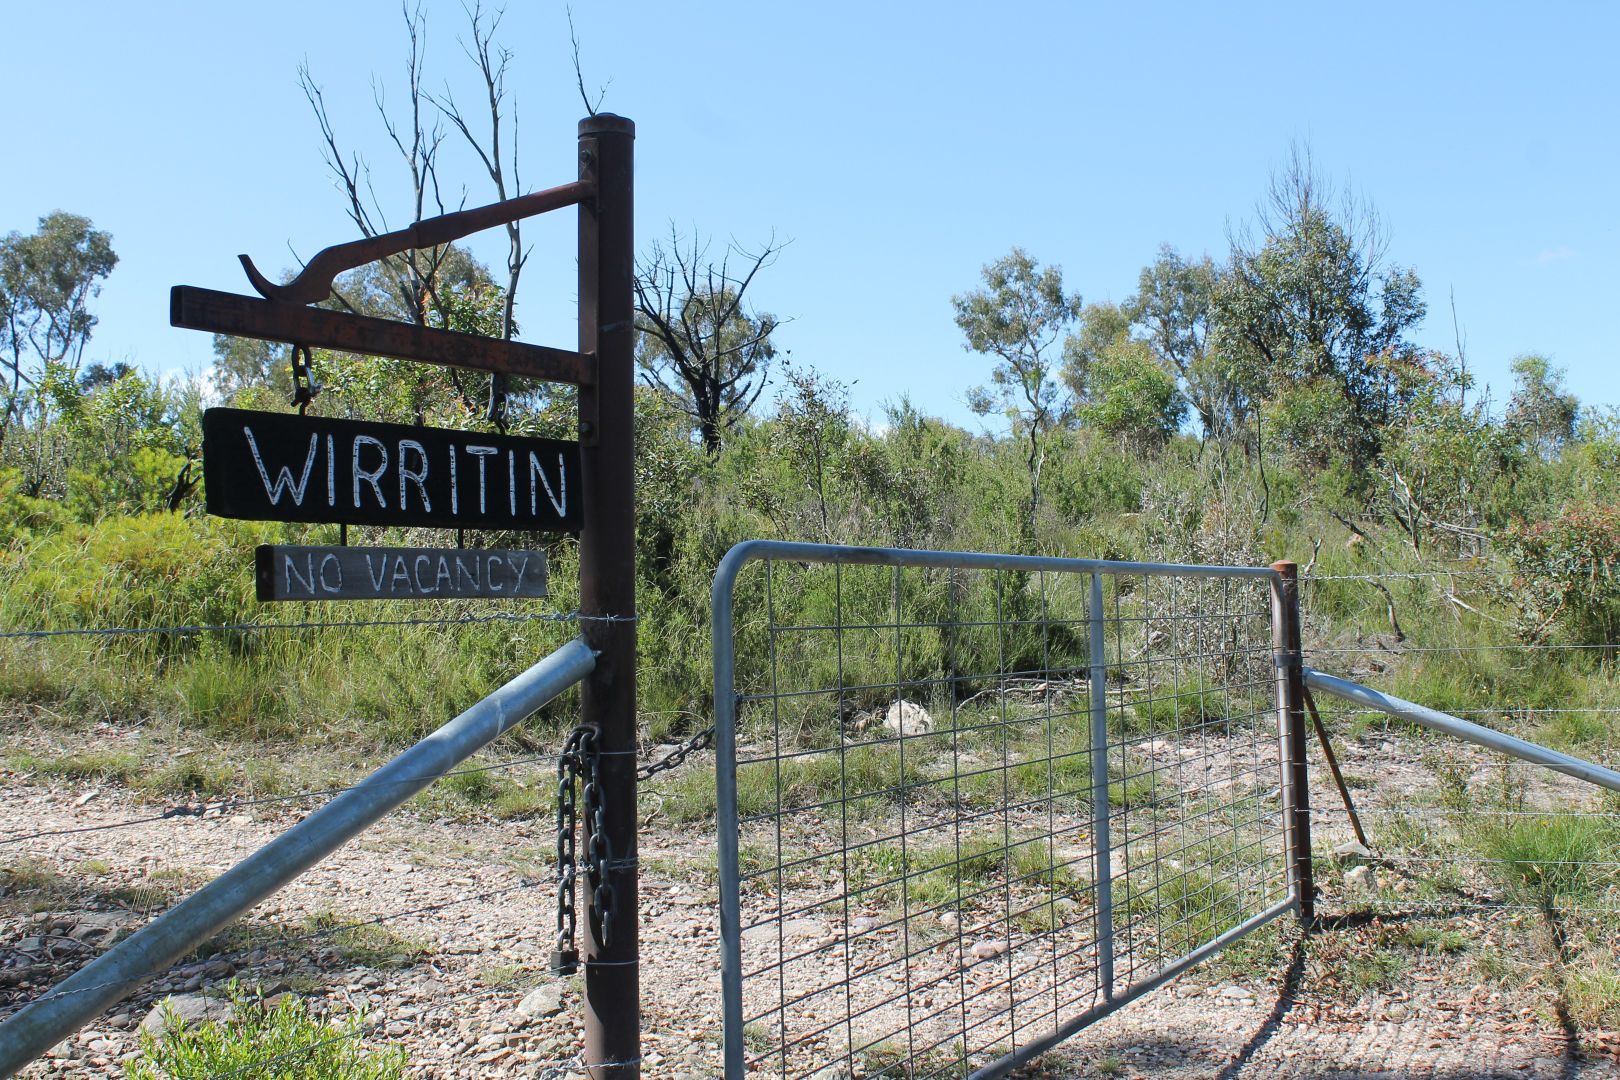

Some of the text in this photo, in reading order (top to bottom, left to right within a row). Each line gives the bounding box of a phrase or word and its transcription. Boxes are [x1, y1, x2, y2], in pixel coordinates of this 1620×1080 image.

[244, 426, 567, 518] WIRRITIN
[284, 553, 529, 594] NO VACANCY
